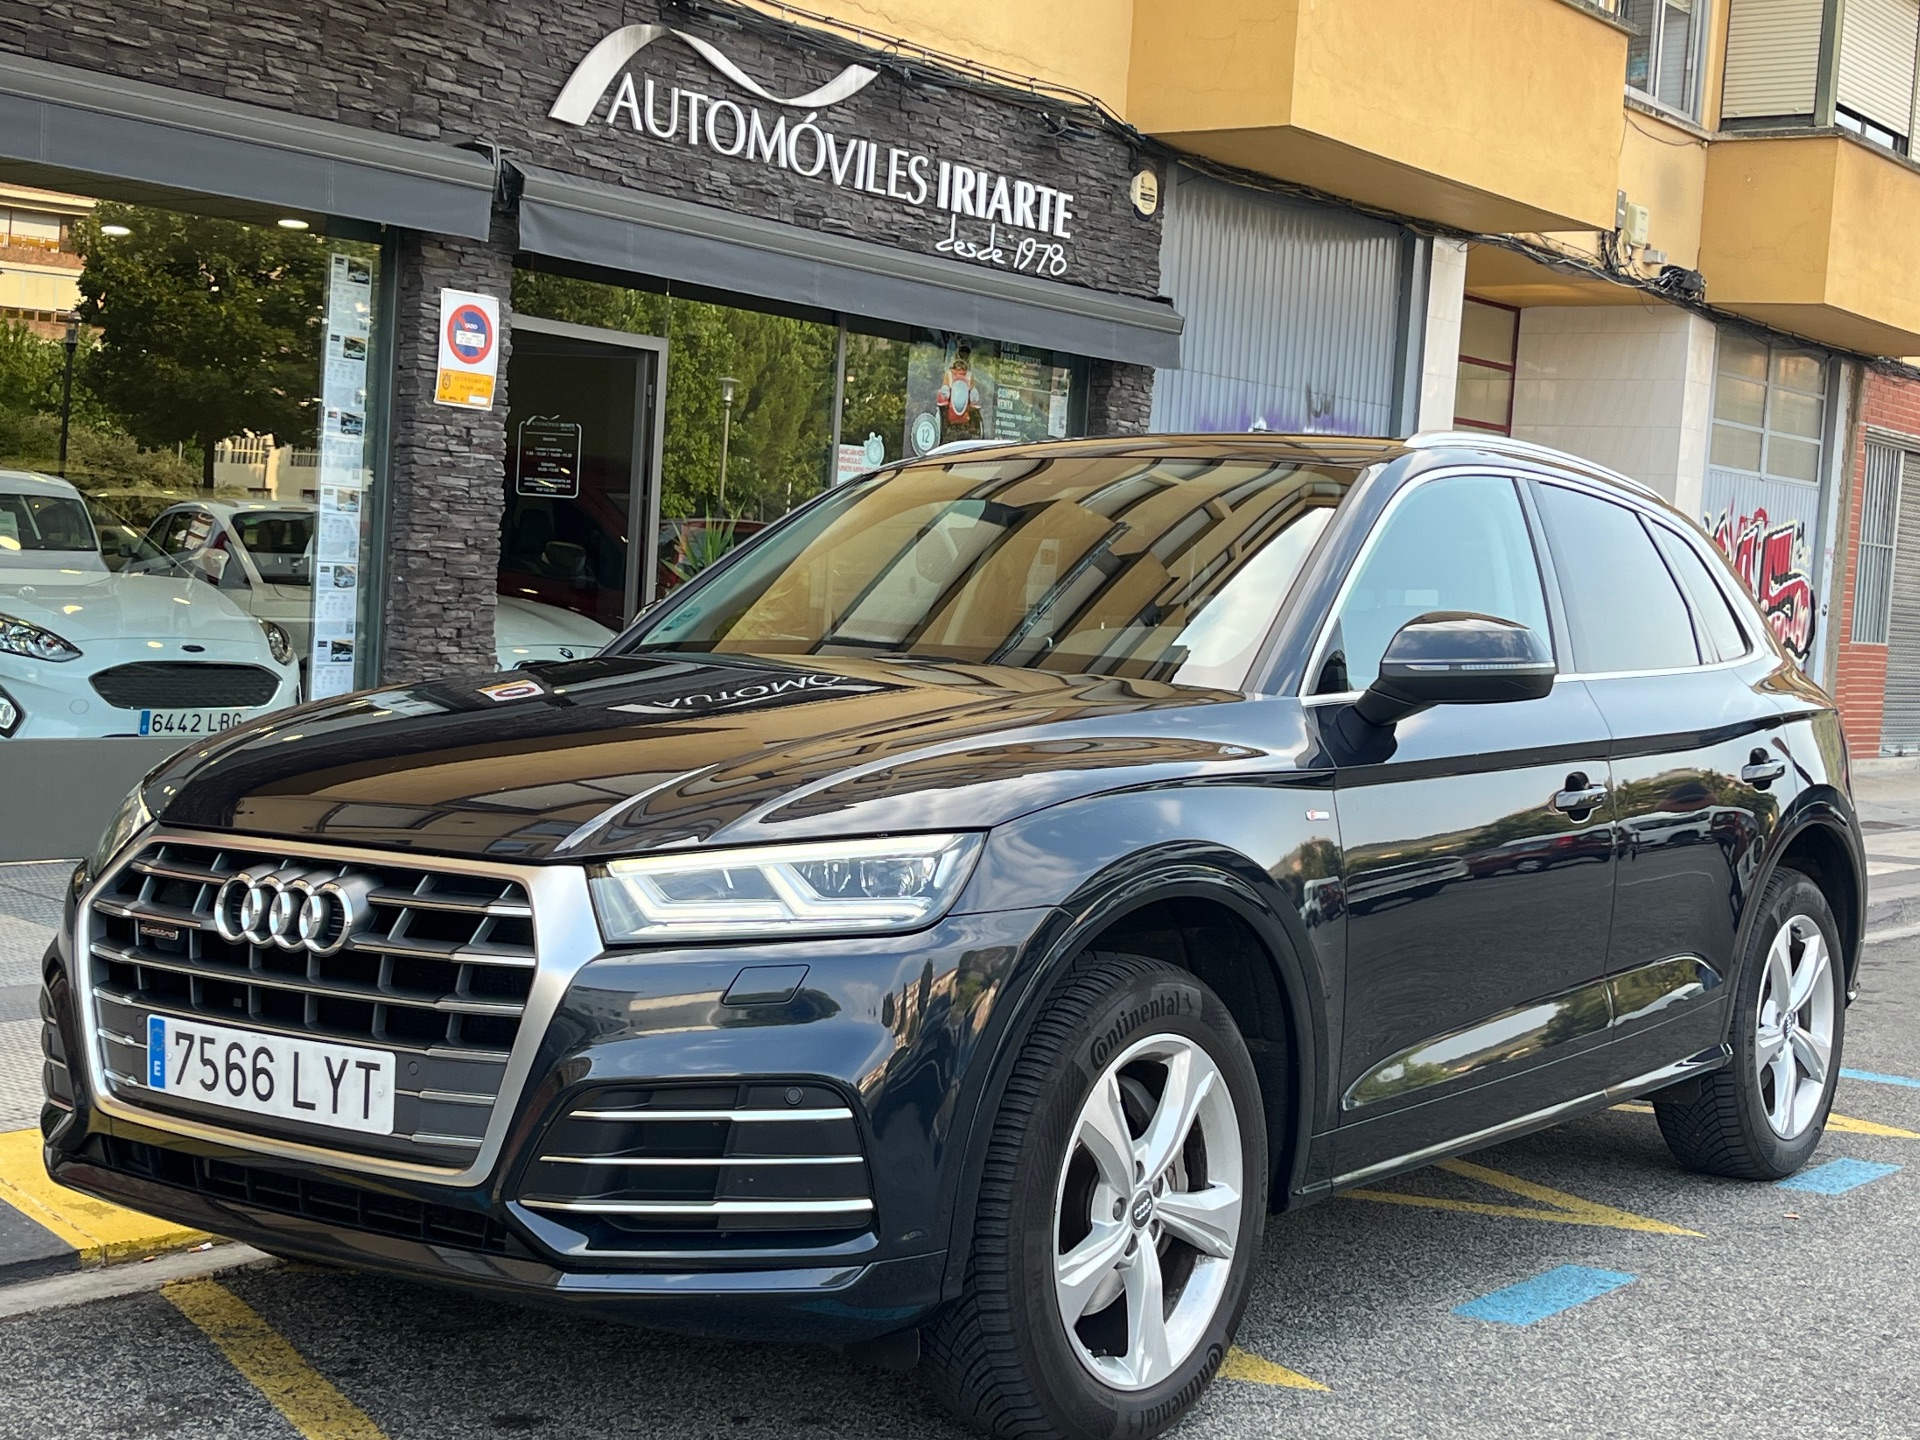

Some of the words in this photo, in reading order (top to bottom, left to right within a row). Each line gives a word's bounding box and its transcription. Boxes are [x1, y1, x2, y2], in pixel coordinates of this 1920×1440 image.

[606, 72, 929, 204] AUTOMÓVILES
[937, 161, 1074, 239] IRIARTE
[935, 213, 1006, 264] desde
[1013, 238, 1067, 275] 1978
[921, 428, 930, 443] 12
[152, 713, 202, 733] 6442
[1090, 991, 1180, 1070] Continental
[153, 1060, 161, 1077] E
[175, 1031, 275, 1102] 7566
[293, 1051, 381, 1120] LYT
